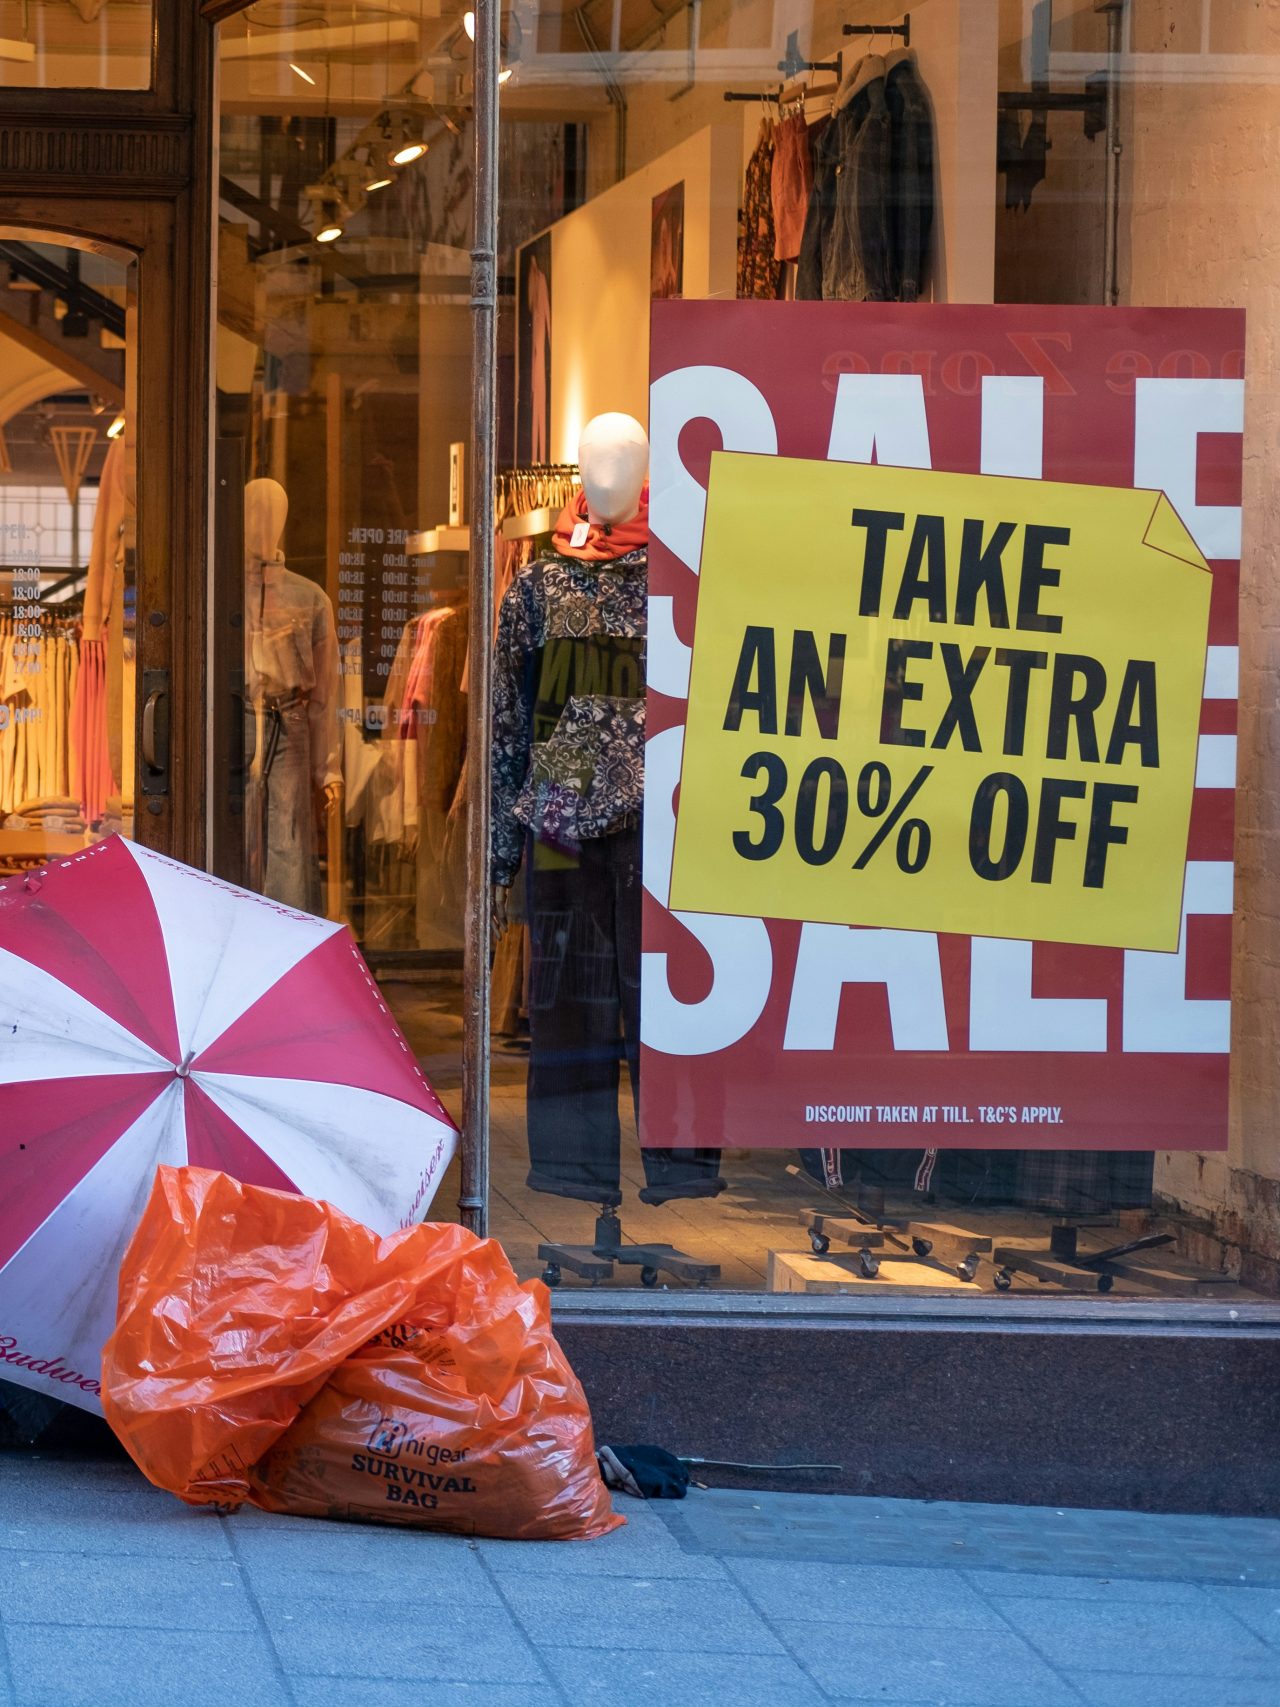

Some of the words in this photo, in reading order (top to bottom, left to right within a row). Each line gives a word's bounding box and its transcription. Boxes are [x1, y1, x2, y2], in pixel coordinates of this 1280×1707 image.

[12, 568, 41, 581] 18:00
[851, 508, 1072, 635] TAKE
[12, 586, 41, 600] 18:00
[13, 605, 41, 619] 18:00
[13, 624, 41, 637] 18:00
[722, 625, 848, 741] AN
[878, 636, 1162, 768] EXTRA
[731, 751, 936, 875] 30%
[968, 771, 1141, 889] OFF
[139, 849, 325, 927] Budweiser
[805, 1105, 872, 1123] DISCOUNT
[876, 1106, 918, 1123] TAKEN
[922, 1106, 939, 1123] AT
[942, 1106, 974, 1123] TILL.
[1021, 1106, 1064, 1124] APPLY.
[426, 1445, 471, 1467] gear
[351, 1454, 477, 1493] SURVIVAL
[386, 1484, 439, 1510] BAG
